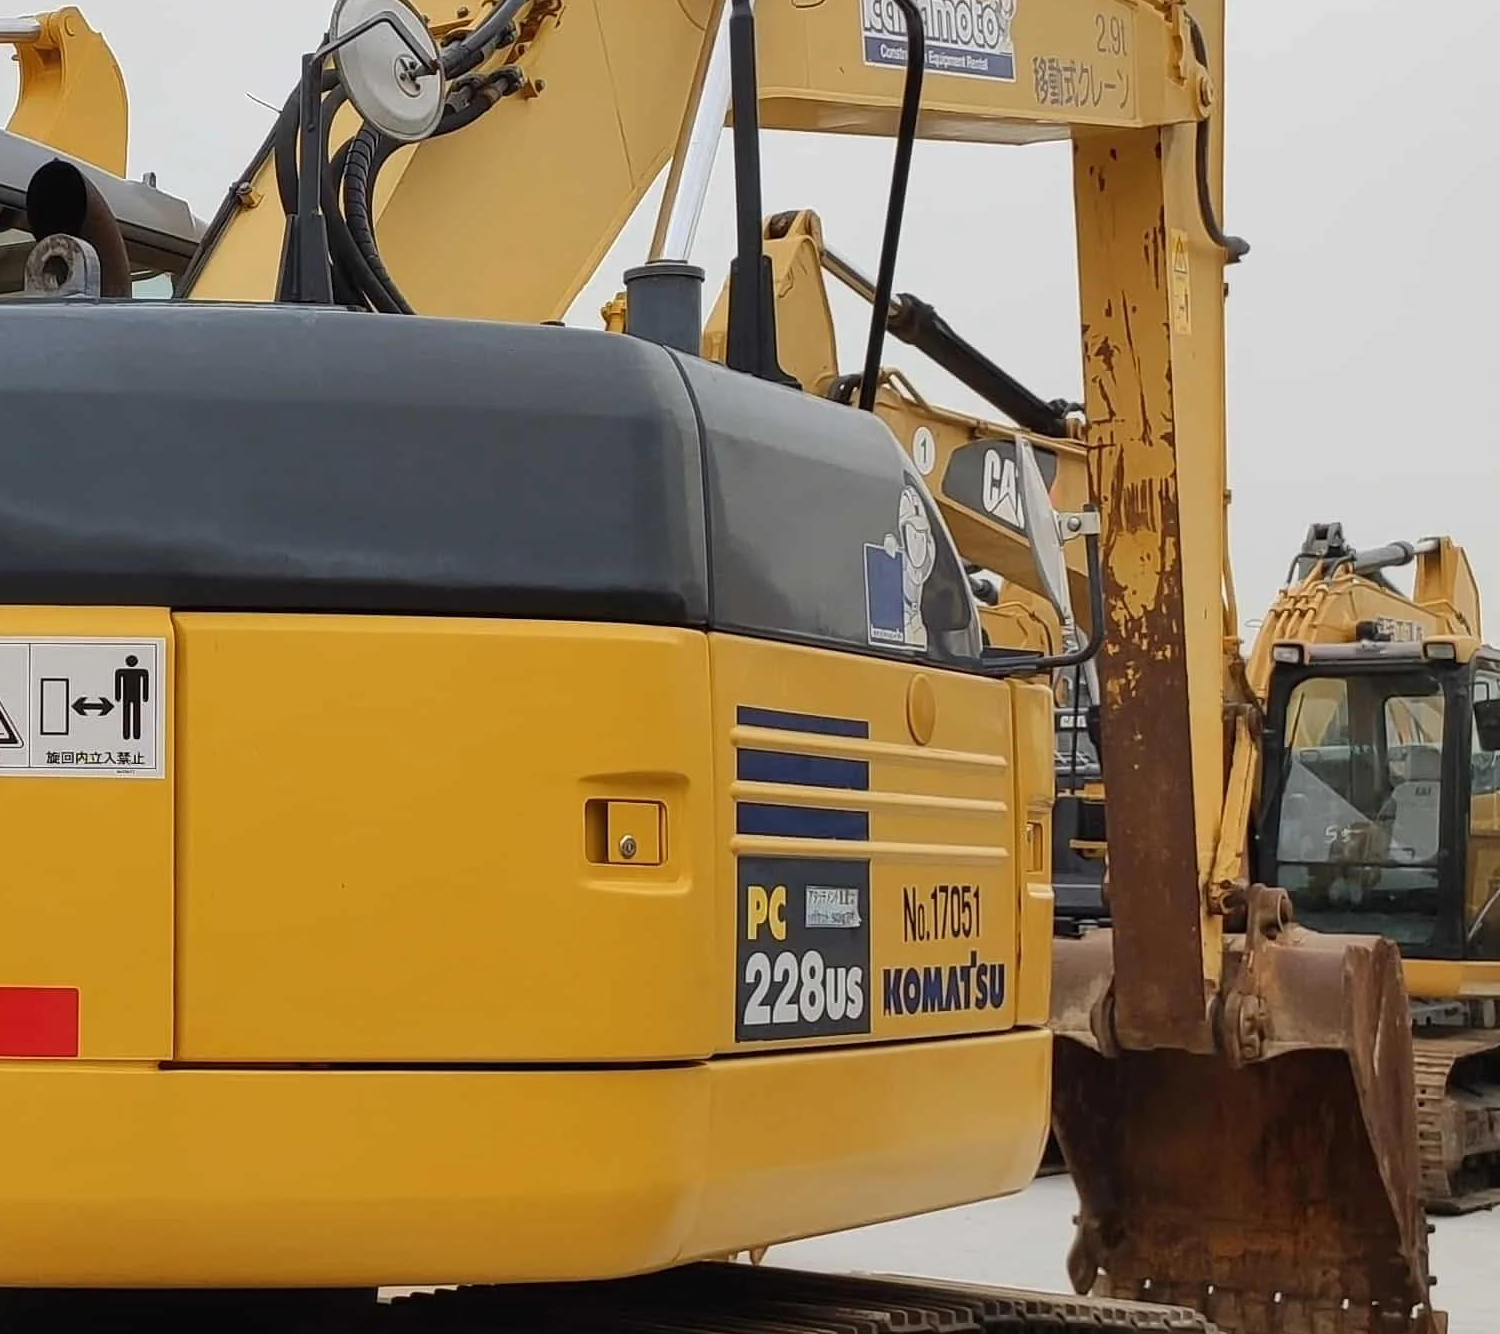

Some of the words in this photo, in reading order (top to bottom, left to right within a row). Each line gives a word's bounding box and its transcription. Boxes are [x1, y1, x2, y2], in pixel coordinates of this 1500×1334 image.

[1033, 56, 1129, 109] 移動式クレーン
[982, 449, 1025, 530] CA
[46, 750, 146, 767] 旋回内立入禁止
[747, 885, 787, 941] PC
[902, 884, 981, 943] No.17051
[882, 949, 1006, 1016] KOMATSU
